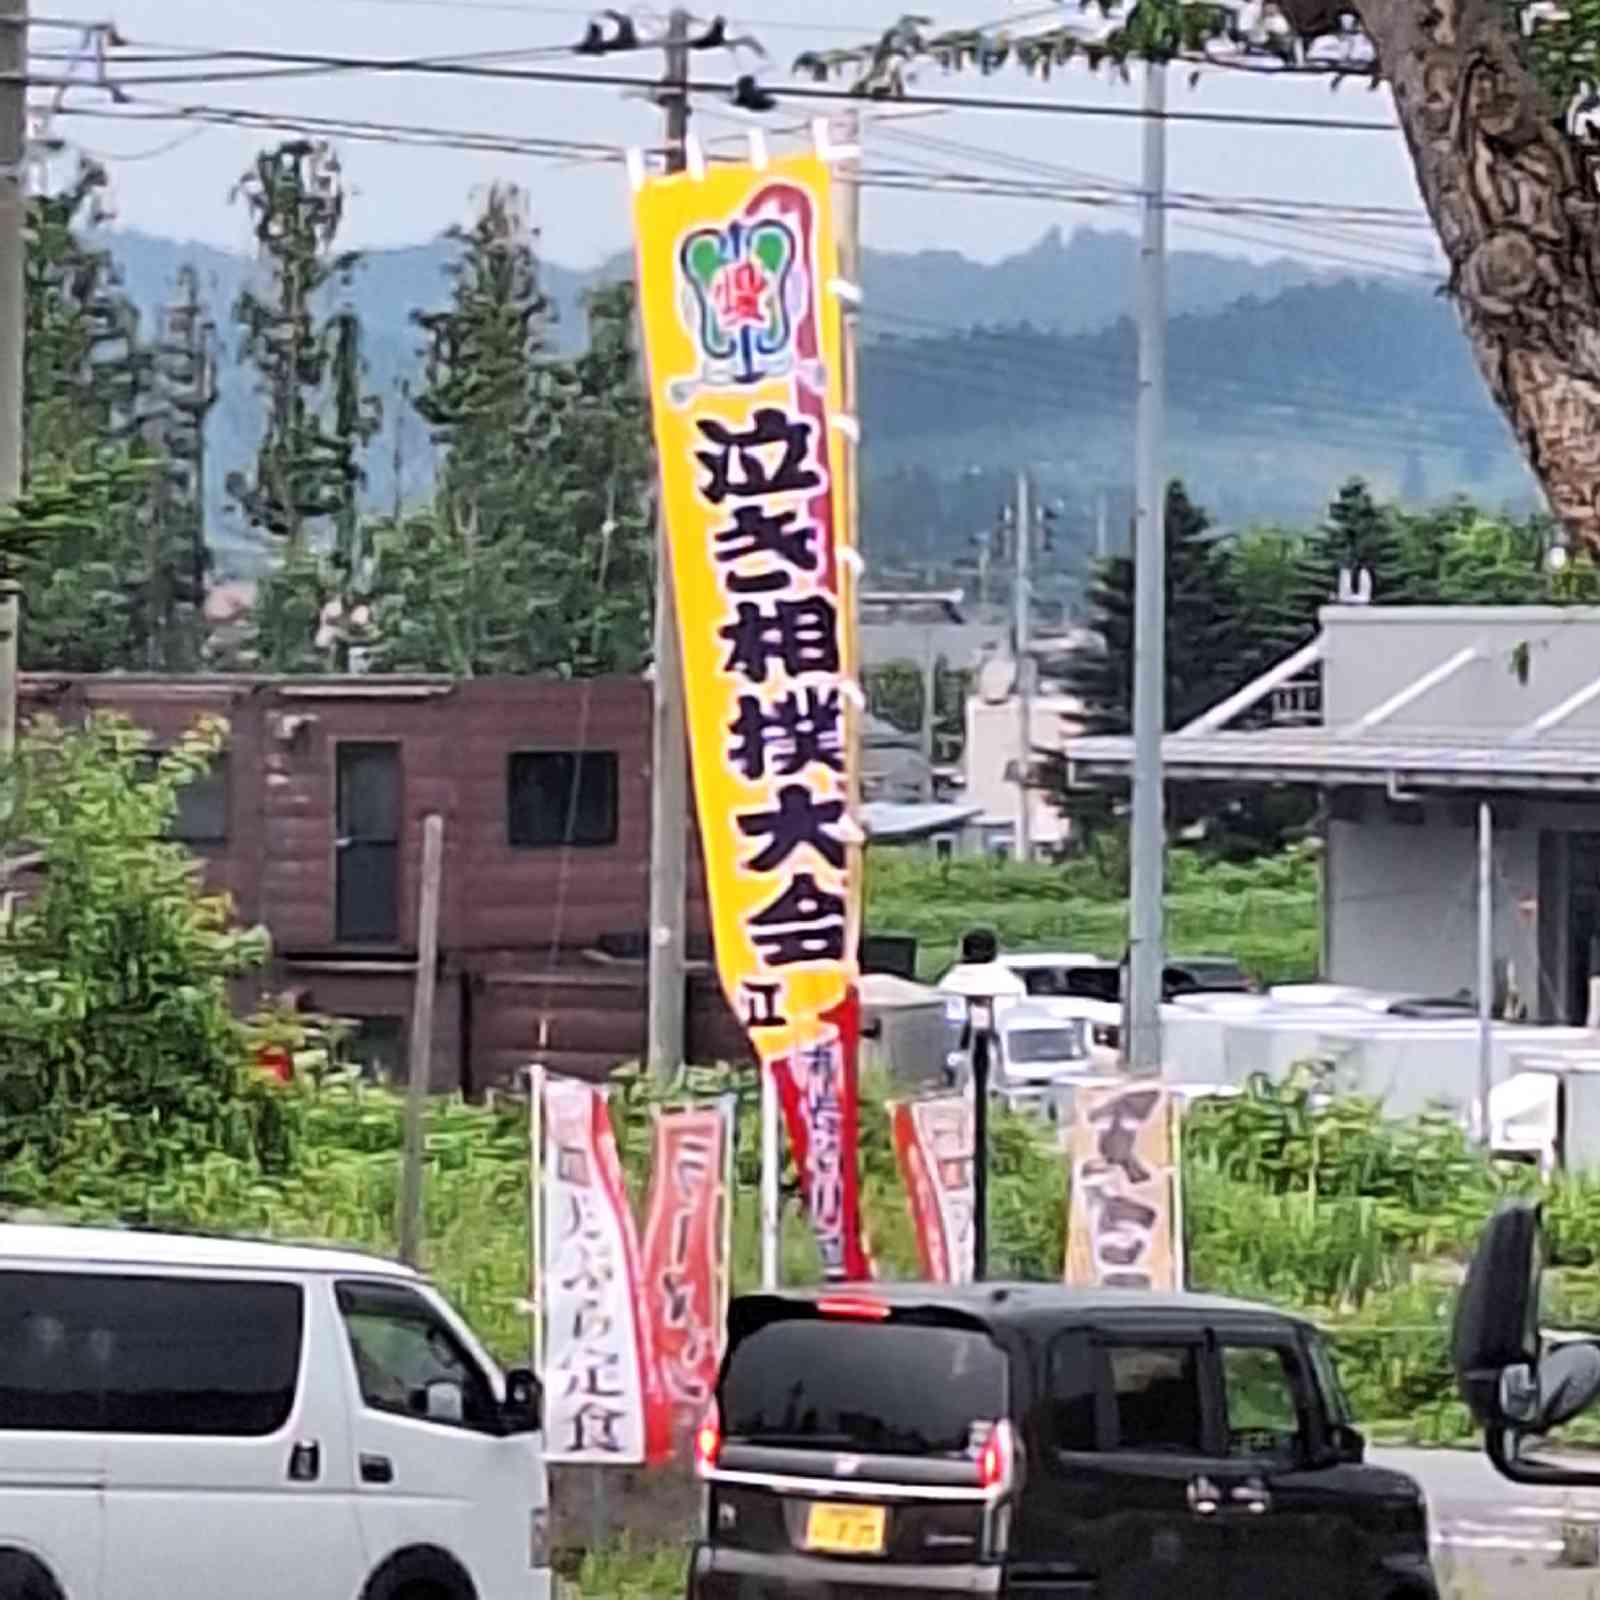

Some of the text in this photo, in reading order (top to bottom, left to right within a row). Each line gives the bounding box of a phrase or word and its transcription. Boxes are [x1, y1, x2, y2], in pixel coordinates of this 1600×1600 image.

[695, 406, 846, 967] 泣き相撲大会
